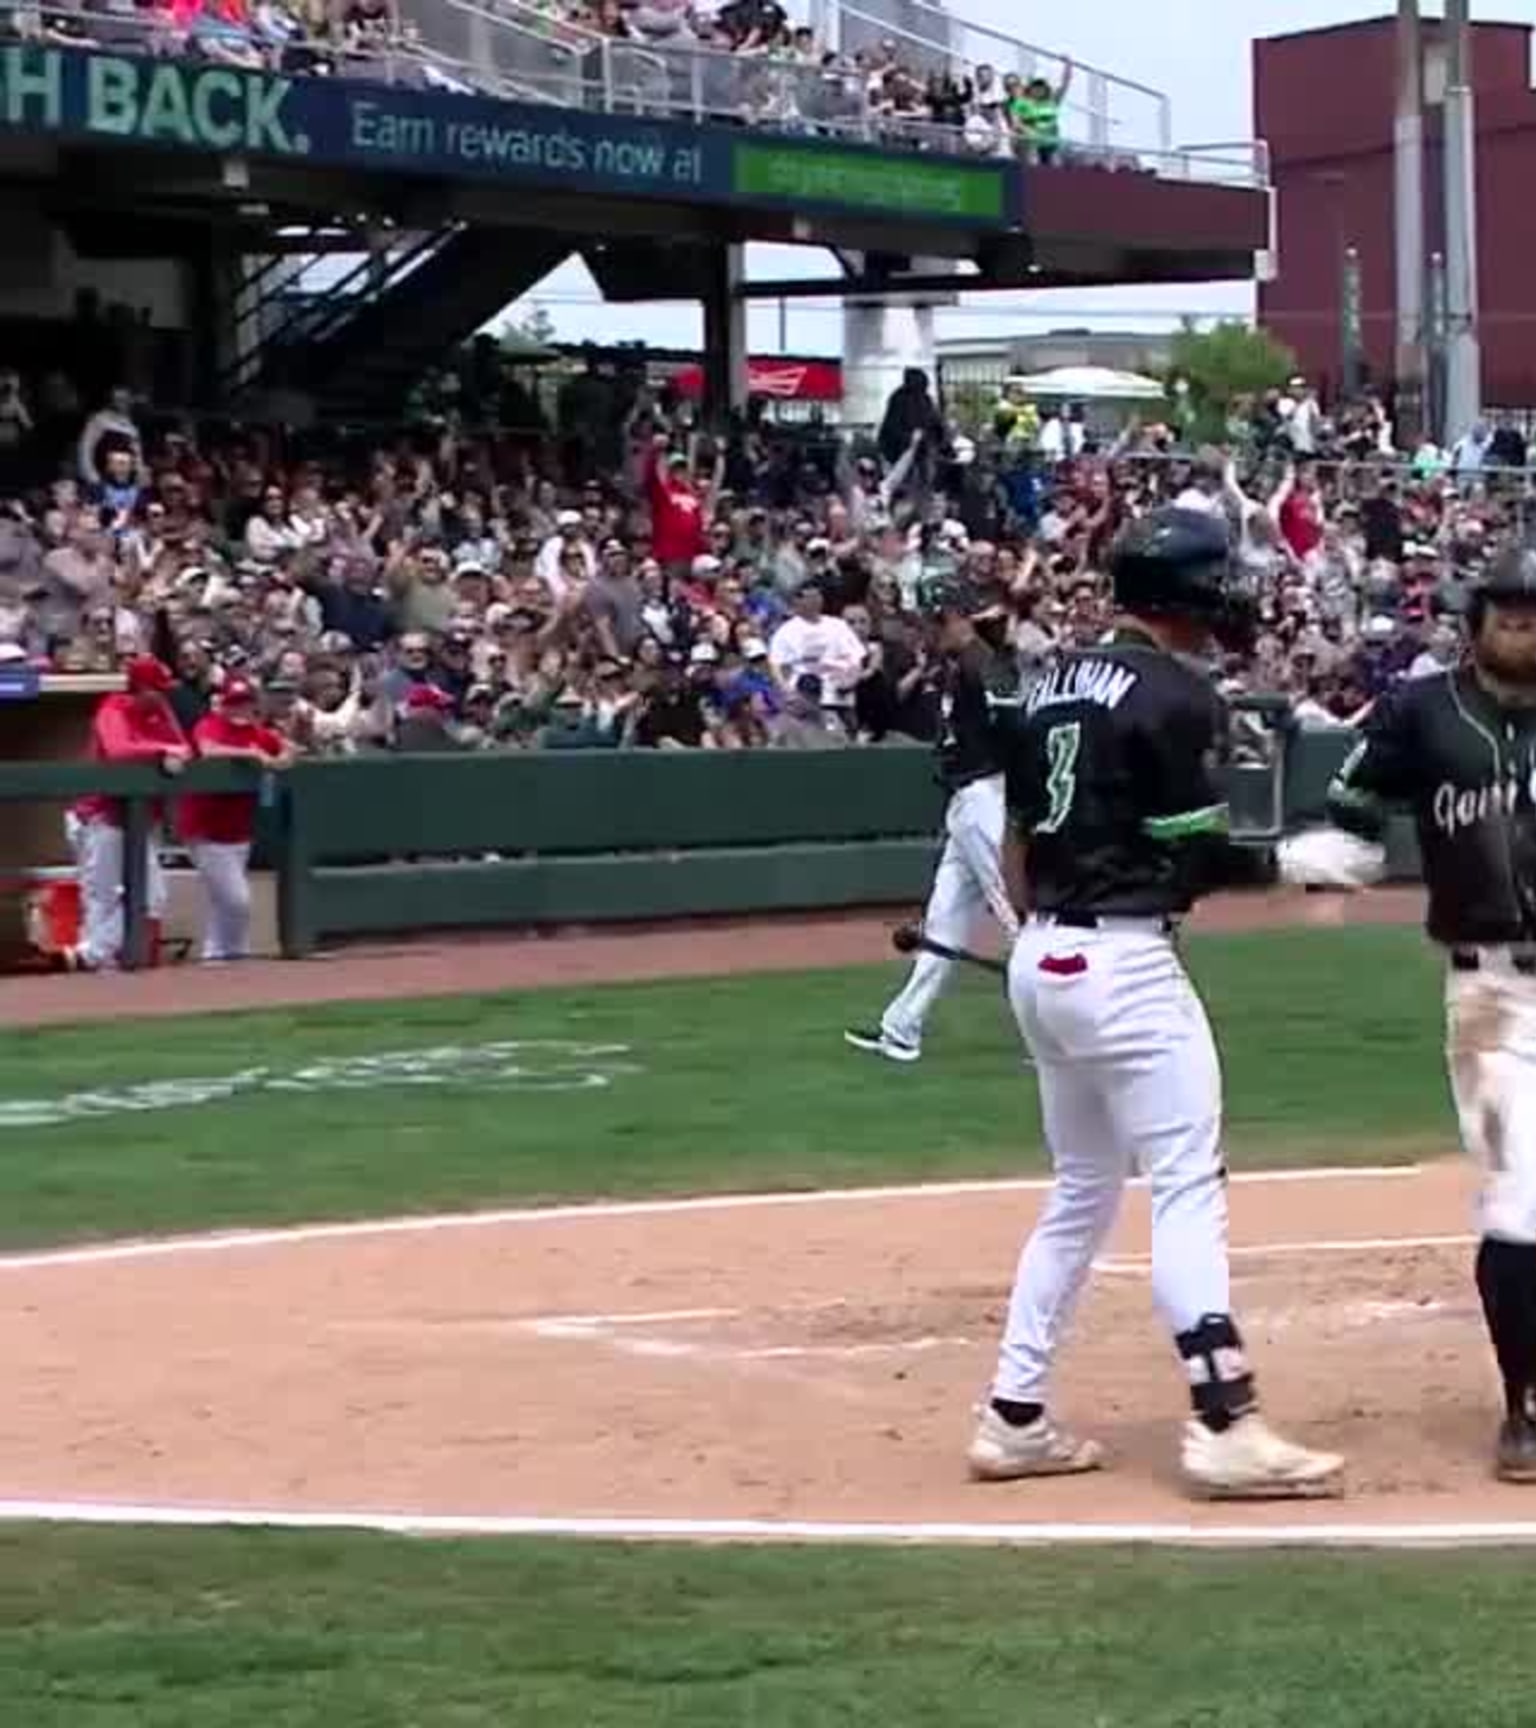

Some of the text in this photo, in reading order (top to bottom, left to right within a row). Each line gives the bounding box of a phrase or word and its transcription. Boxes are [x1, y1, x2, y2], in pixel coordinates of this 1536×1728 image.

[0, 47, 311, 154] H BACK.
[445, 122, 587, 170] rewards
[593, 138, 664, 175] now
